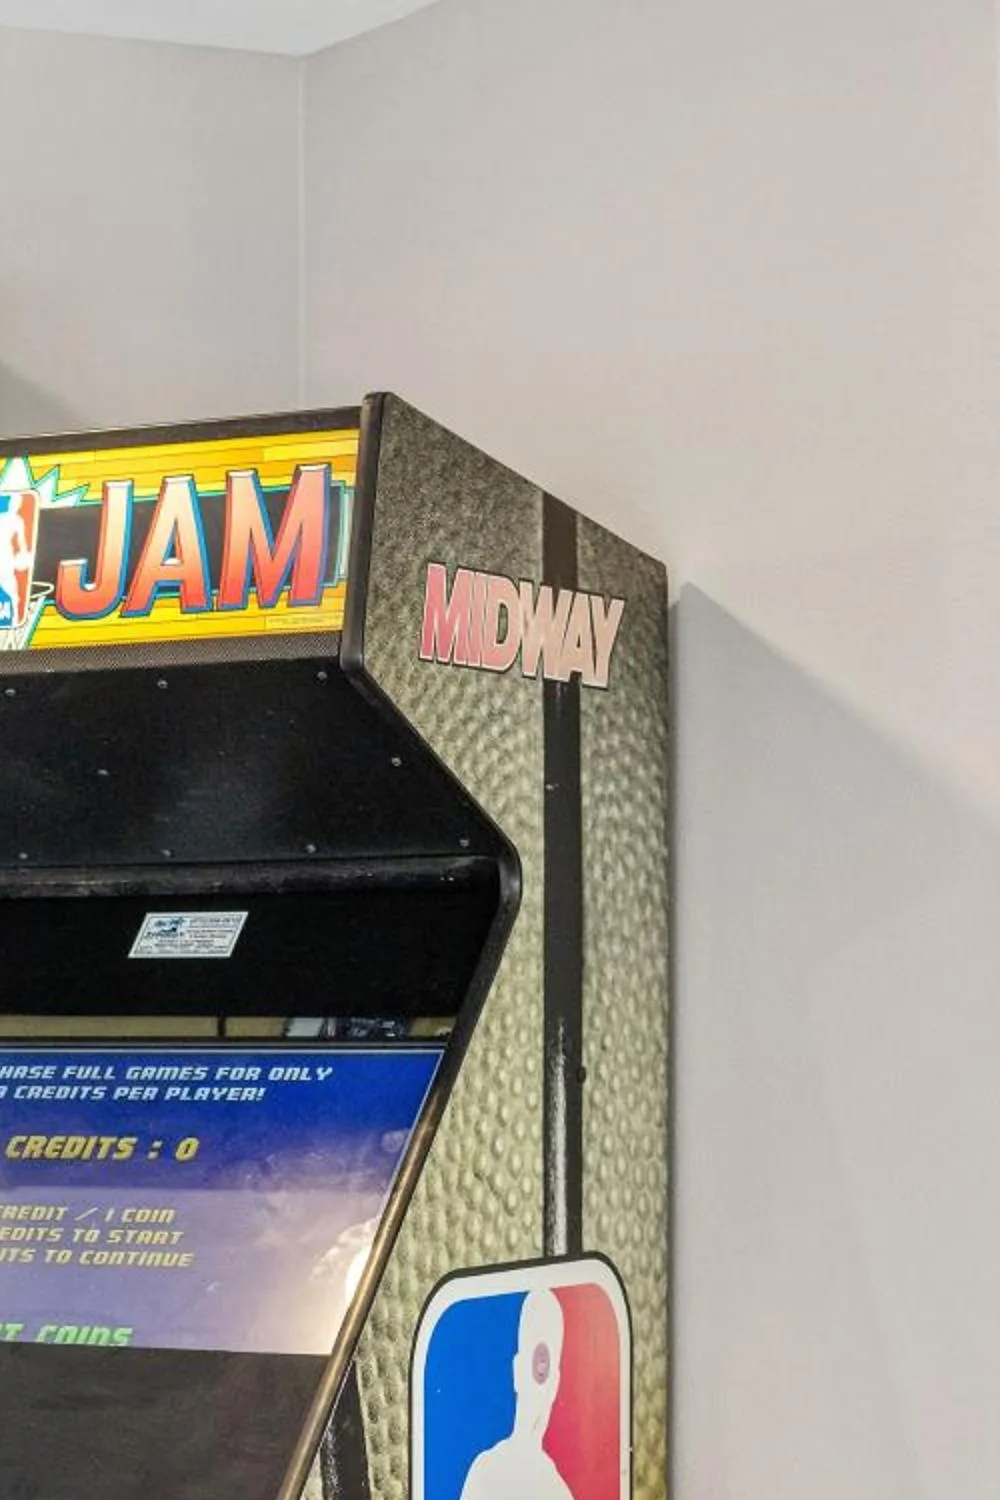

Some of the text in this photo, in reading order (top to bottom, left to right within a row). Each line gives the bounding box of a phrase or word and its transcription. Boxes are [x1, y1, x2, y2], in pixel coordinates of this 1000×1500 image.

[56, 463, 331, 619] JAM
[418, 561, 628, 690] MIDWAY
[62, 1066, 117, 1080] FULL
[126, 1066, 209, 1081] GAMES
[214, 1067, 262, 1081] FOR
[268, 1067, 333, 1081] ONLY
[13, 1085, 107, 1100] CREDITS
[113, 1086, 158, 1101] PER
[164, 1087, 266, 1102] PLAYER!
[4, 1135, 138, 1161] CREDITS
[121, 1209, 175, 1223] COIN
[72, 1228, 100, 1243] TO
[106, 1230, 184, 1244] START
[44, 1249, 73, 1264] TO
[80, 1250, 194, 1267] CONTINUE
